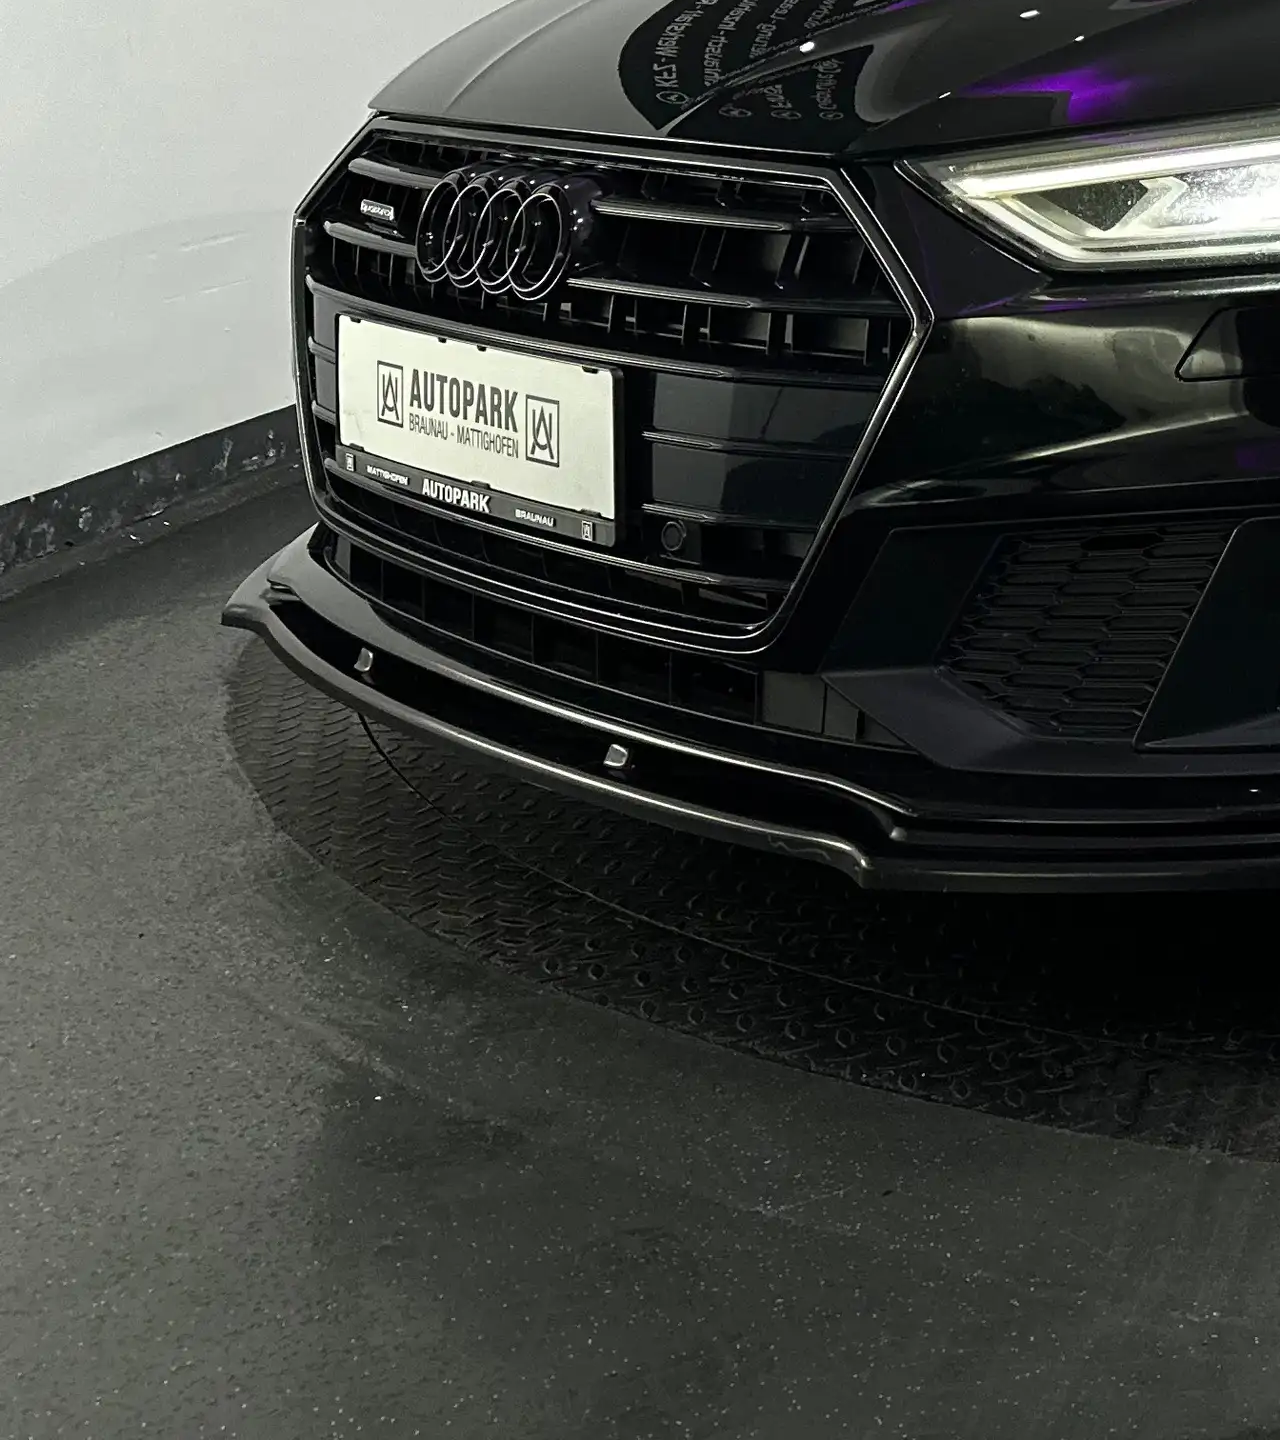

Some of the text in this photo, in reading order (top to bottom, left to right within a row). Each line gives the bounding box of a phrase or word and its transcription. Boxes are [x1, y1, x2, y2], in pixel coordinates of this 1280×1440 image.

[409, 368, 519, 434] AUTOPARK
[408, 412, 449, 442] BRAUNAU
[456, 424, 520, 460] MATTIGHOFEN
[422, 477, 491, 514] AUTOPARK
[514, 508, 555, 528] BRAUNAU
